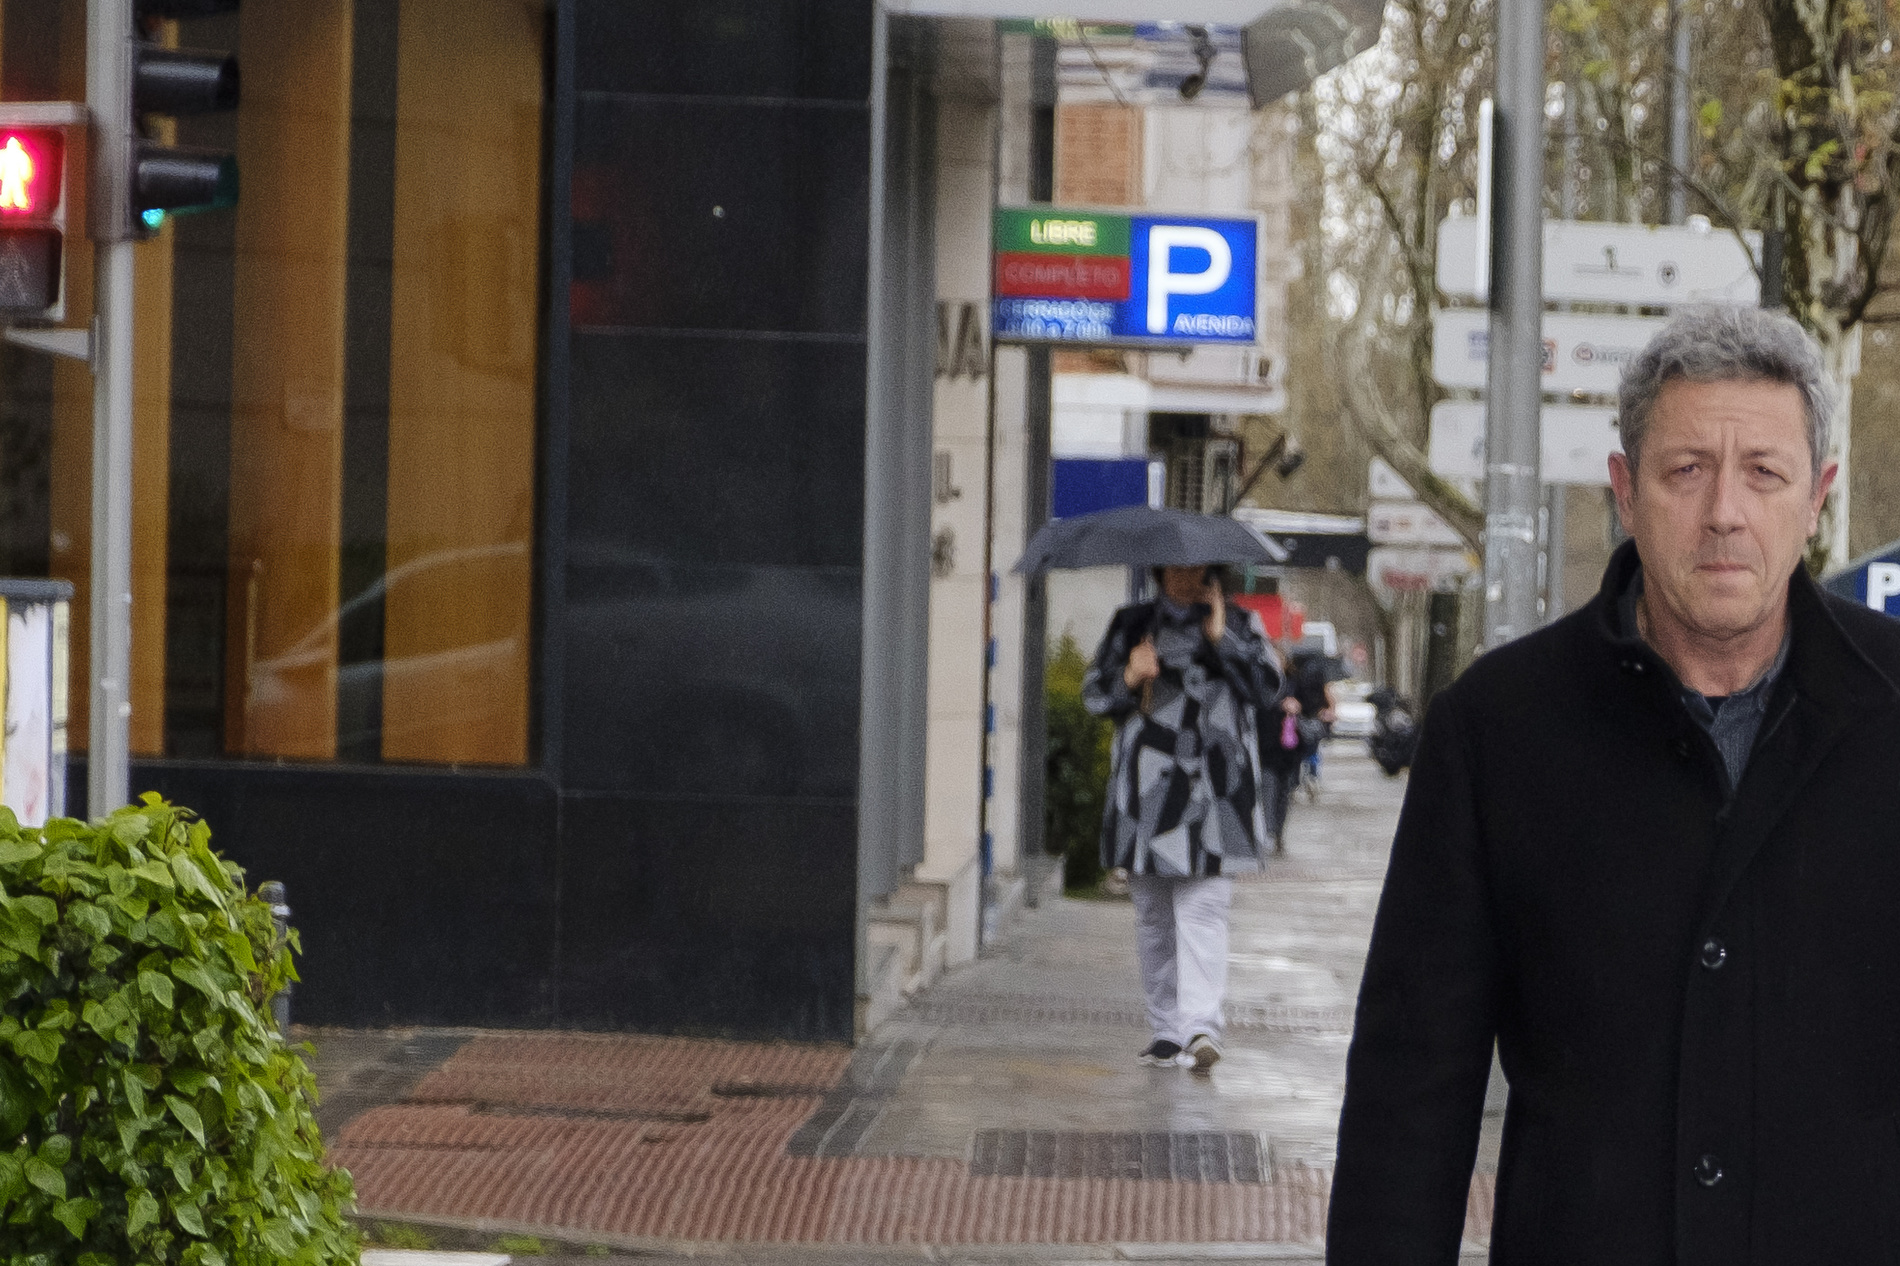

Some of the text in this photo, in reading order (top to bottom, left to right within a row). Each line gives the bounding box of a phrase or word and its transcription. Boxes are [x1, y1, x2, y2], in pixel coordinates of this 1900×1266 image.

[1031, 219, 1097, 246] LIBRE
[1003, 261, 1122, 288] COMPLETO
[1146, 225, 1232, 334] P
[1173, 312, 1254, 337] AVENIDA
